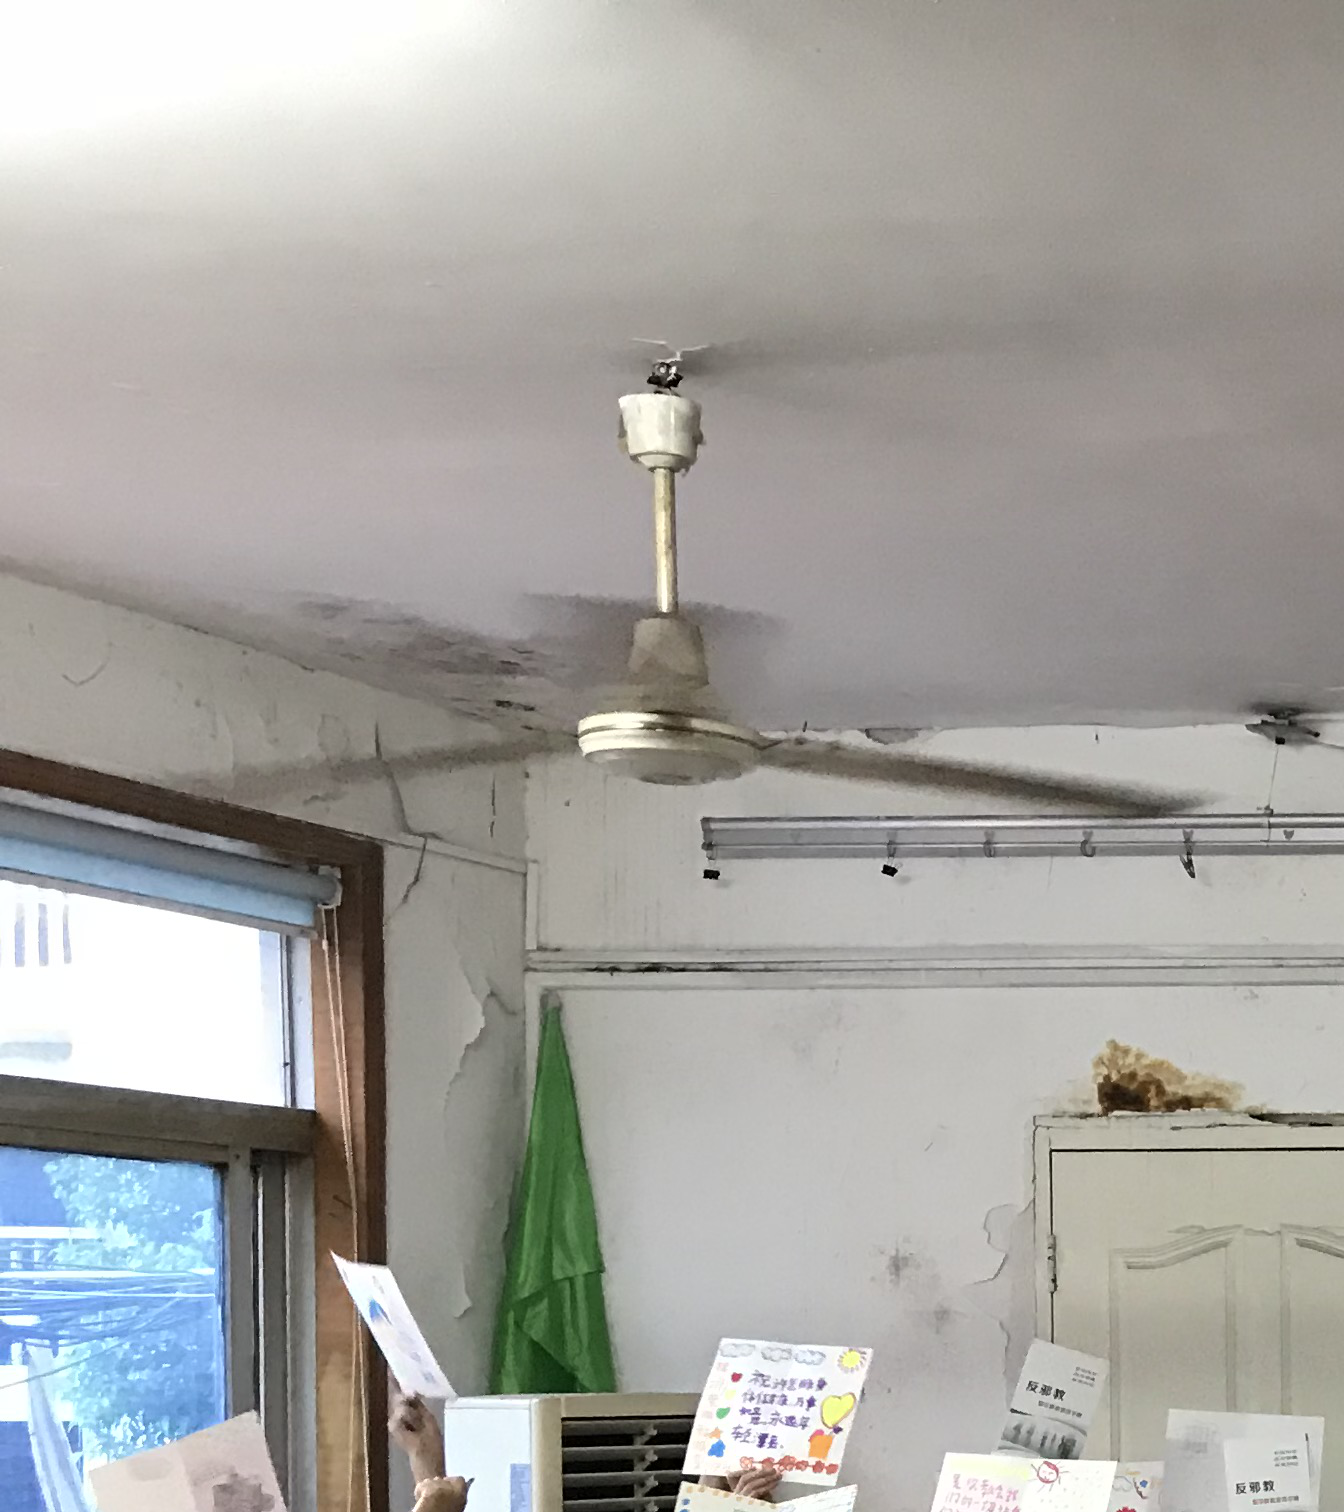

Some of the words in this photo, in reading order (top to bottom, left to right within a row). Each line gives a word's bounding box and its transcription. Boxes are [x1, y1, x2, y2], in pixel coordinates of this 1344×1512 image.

[1026, 1380, 1066, 1401] 反邪教
[1235, 1480, 1275, 1495] 反邪教
